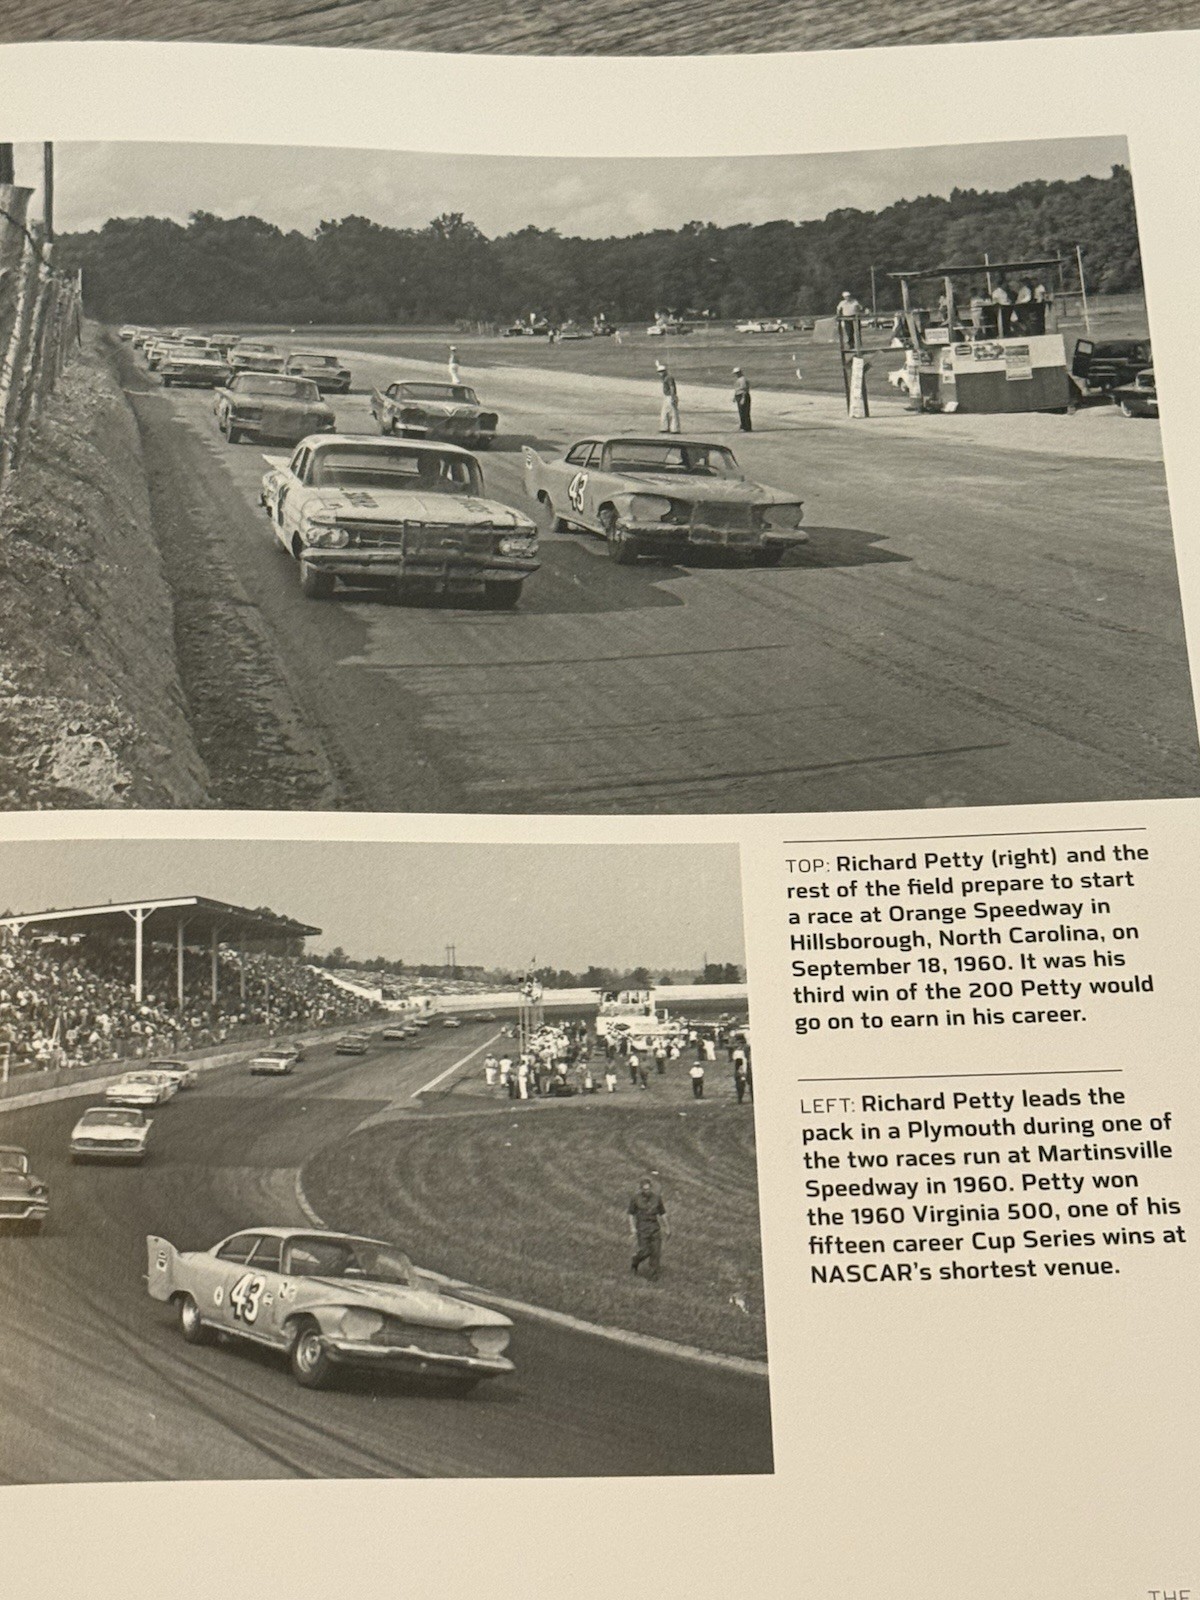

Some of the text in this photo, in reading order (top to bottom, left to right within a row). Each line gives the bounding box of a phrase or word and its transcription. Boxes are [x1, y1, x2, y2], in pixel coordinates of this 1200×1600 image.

[567, 472, 589, 515] 43
[784, 843, 1150, 874] TOP: Richard Petty (right) and the
[786, 870, 1136, 900] rest of the field prepare to start
[788, 897, 1111, 926] a race at Orange Speedway in
[789, 923, 1140, 953] Hillsborough, North Carolina, on
[791, 949, 1126, 981] September 18, 1960. It was his
[792, 973, 1155, 1005] third win of the 200 Petty would
[794, 1006, 1087, 1036] go on to earn in his career.
[800, 1087, 1126, 1115] LEFT: Richard Petty leads the
[801, 1111, 1173, 1147] pack in a Plymouth during one of
[802, 1139, 1173, 1170] the two races run at Martinsville
[804, 1172, 1139, 1203] Speedway in 1960. Petty won
[805, 1196, 1182, 1228] the 1960 Virginia 500, one of his
[807, 1224, 1188, 1255] fifteen career Cup Series wins at
[810, 1258, 1121, 1284] NASCAR's shortest venue.
[230, 1272, 266, 1325] 43
